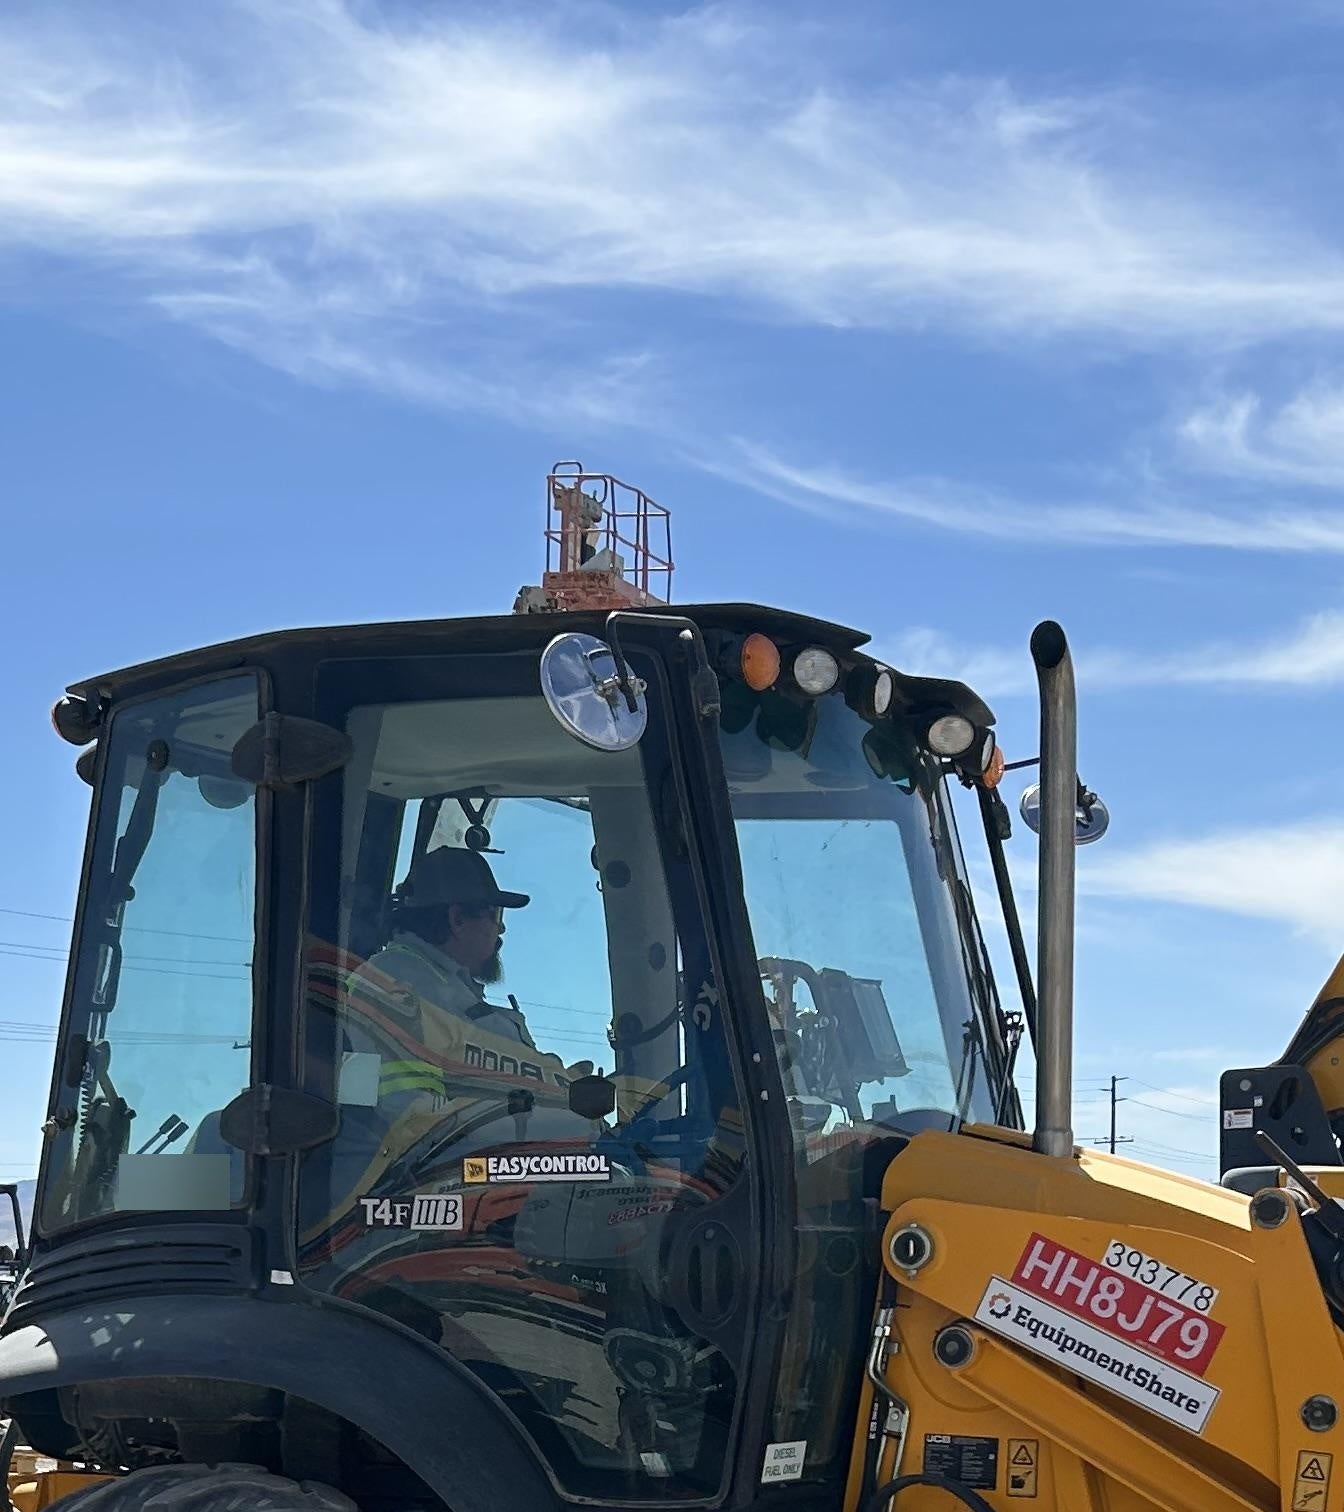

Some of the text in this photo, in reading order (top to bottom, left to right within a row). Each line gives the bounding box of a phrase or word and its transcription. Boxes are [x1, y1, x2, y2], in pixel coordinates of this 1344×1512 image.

[1021, 1239, 1210, 1360] HH8J79
[1105, 1242, 1215, 1312] 393778
[1011, 1305, 1201, 1414] EquipmentShare
